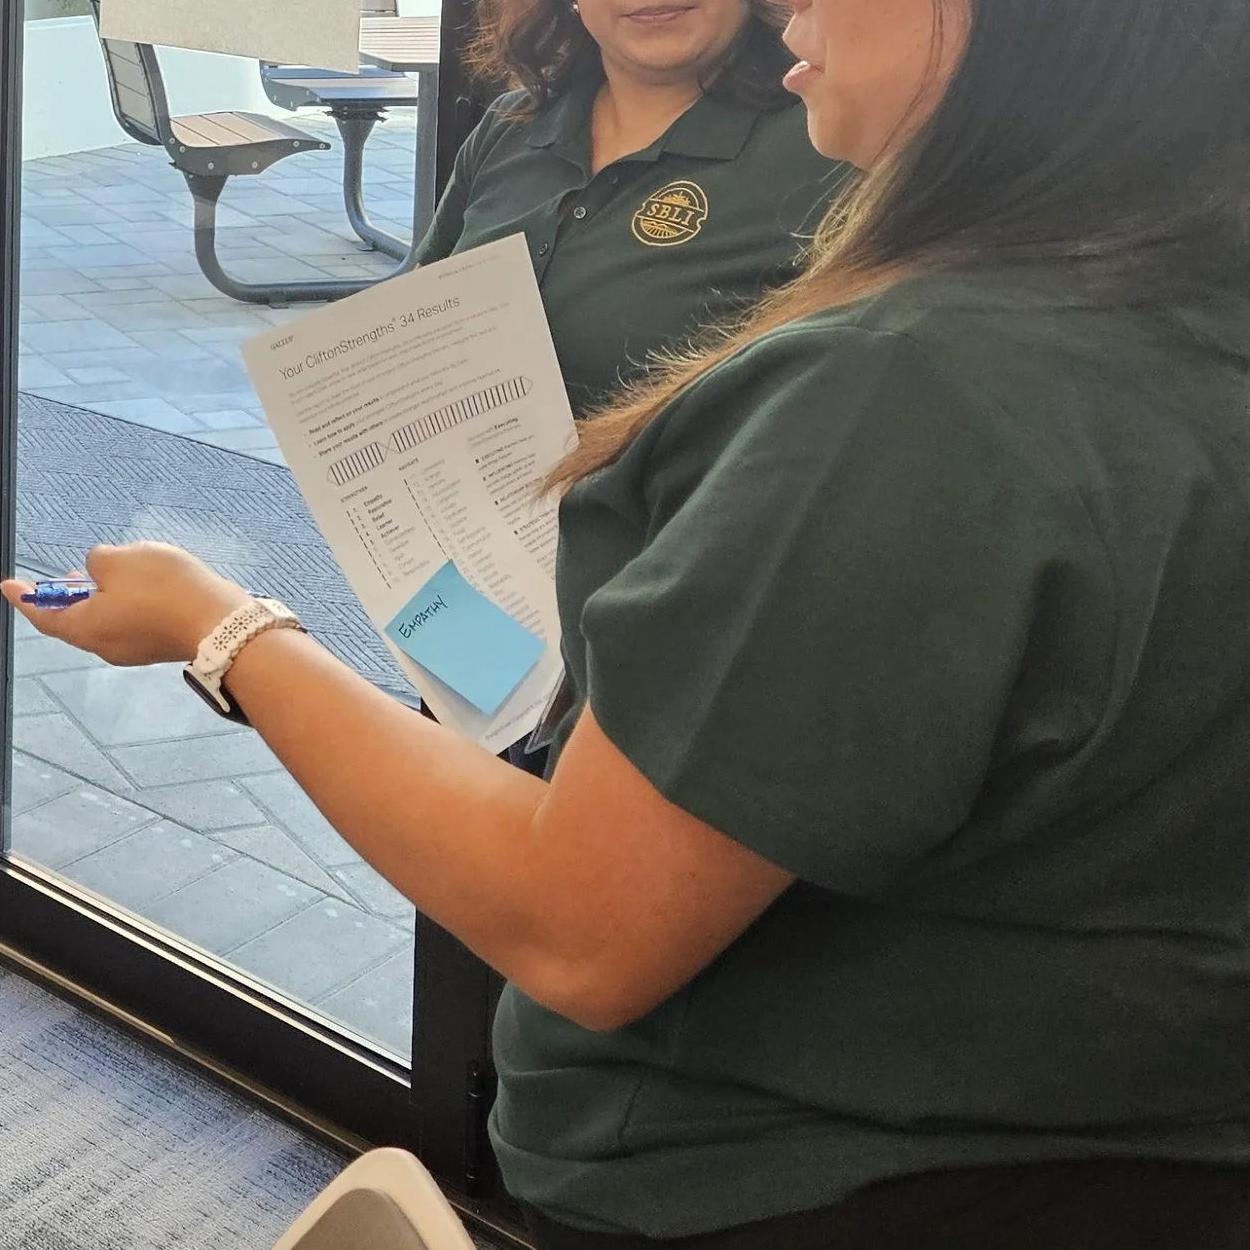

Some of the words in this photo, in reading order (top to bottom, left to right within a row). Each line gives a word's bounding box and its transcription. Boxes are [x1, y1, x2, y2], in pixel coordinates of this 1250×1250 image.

[646, 203, 695, 226] SBLI
[279, 362, 304, 381] Your
[400, 311, 416, 328] 34
[417, 297, 461, 321] Results
[398, 595, 449, 639] EMPATHY
